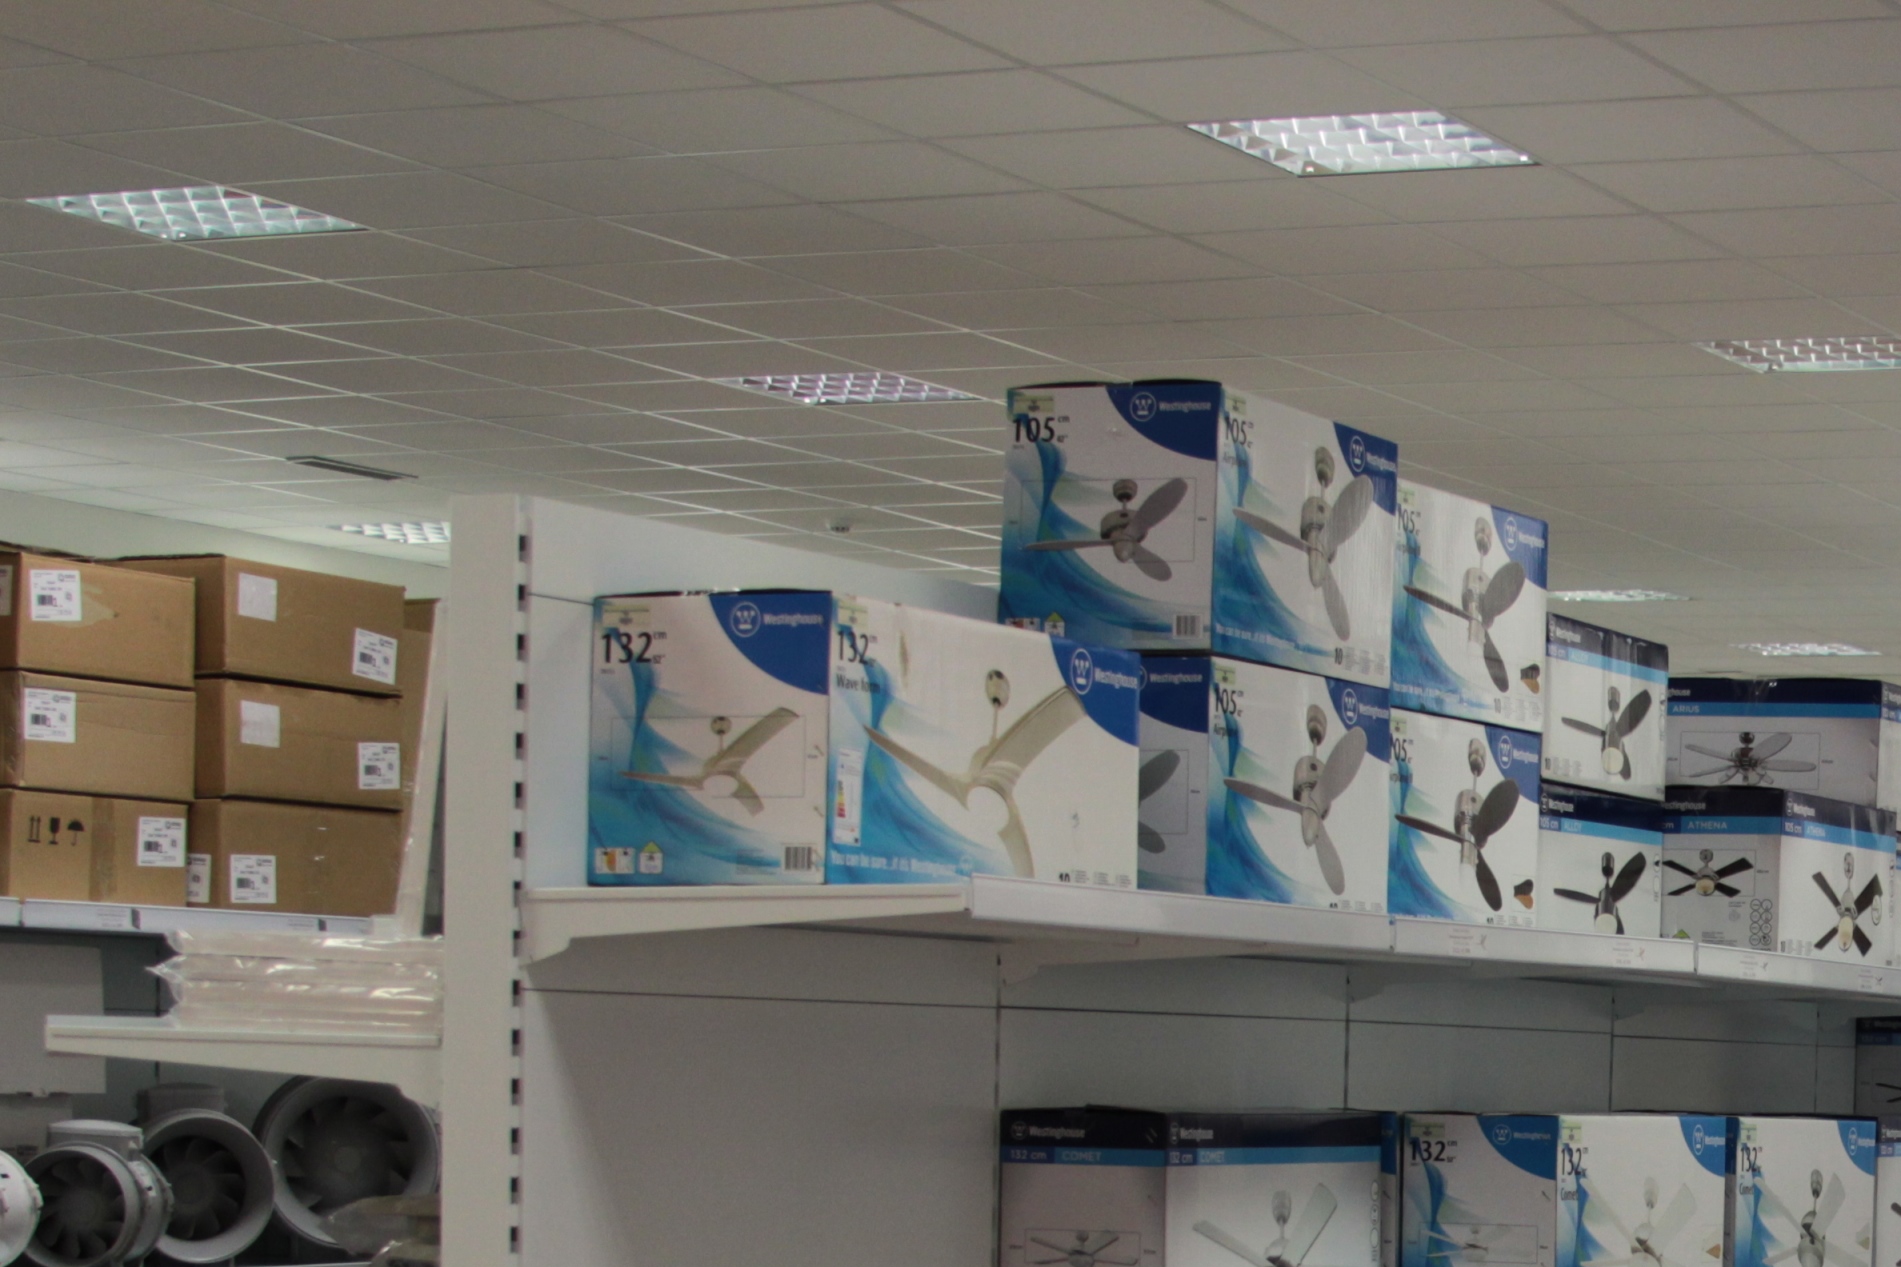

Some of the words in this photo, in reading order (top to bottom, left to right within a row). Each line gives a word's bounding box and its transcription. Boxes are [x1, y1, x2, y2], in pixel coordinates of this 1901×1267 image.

[1159, 402, 1211, 413] Westinghouse
[1013, 418, 1055, 443] 105
[1056, 416, 1070, 425] cm
[1225, 416, 1246, 446] 105
[763, 612, 824, 627] Westinghouse
[602, 632, 652, 664] 132
[653, 630, 667, 640] cm
[837, 630, 869, 665] 132
[837, 674, 860, 690] Wave
[1095, 667, 1139, 690] Westinghouse
[1149, 674, 1203, 685] Westinghouse
[1214, 685, 1237, 715] 105
[1672, 705, 1700, 714] ARIUS
[1687, 820, 1728, 830] ATHENA
[1029, 1125, 1086, 1139] Westinghouse
[1180, 1126, 1214, 1141] Westinghouse
[1513, 1132, 1552, 1141] Westinghouse
[1009, 1150, 1028, 1160] 132
[1033, 1152, 1048, 1161] cm
[1061, 1151, 1103, 1162] COMET
[1409, 1140, 1447, 1162] 132
[1561, 1147, 1582, 1176] 132
[1741, 1147, 1757, 1172] 132
